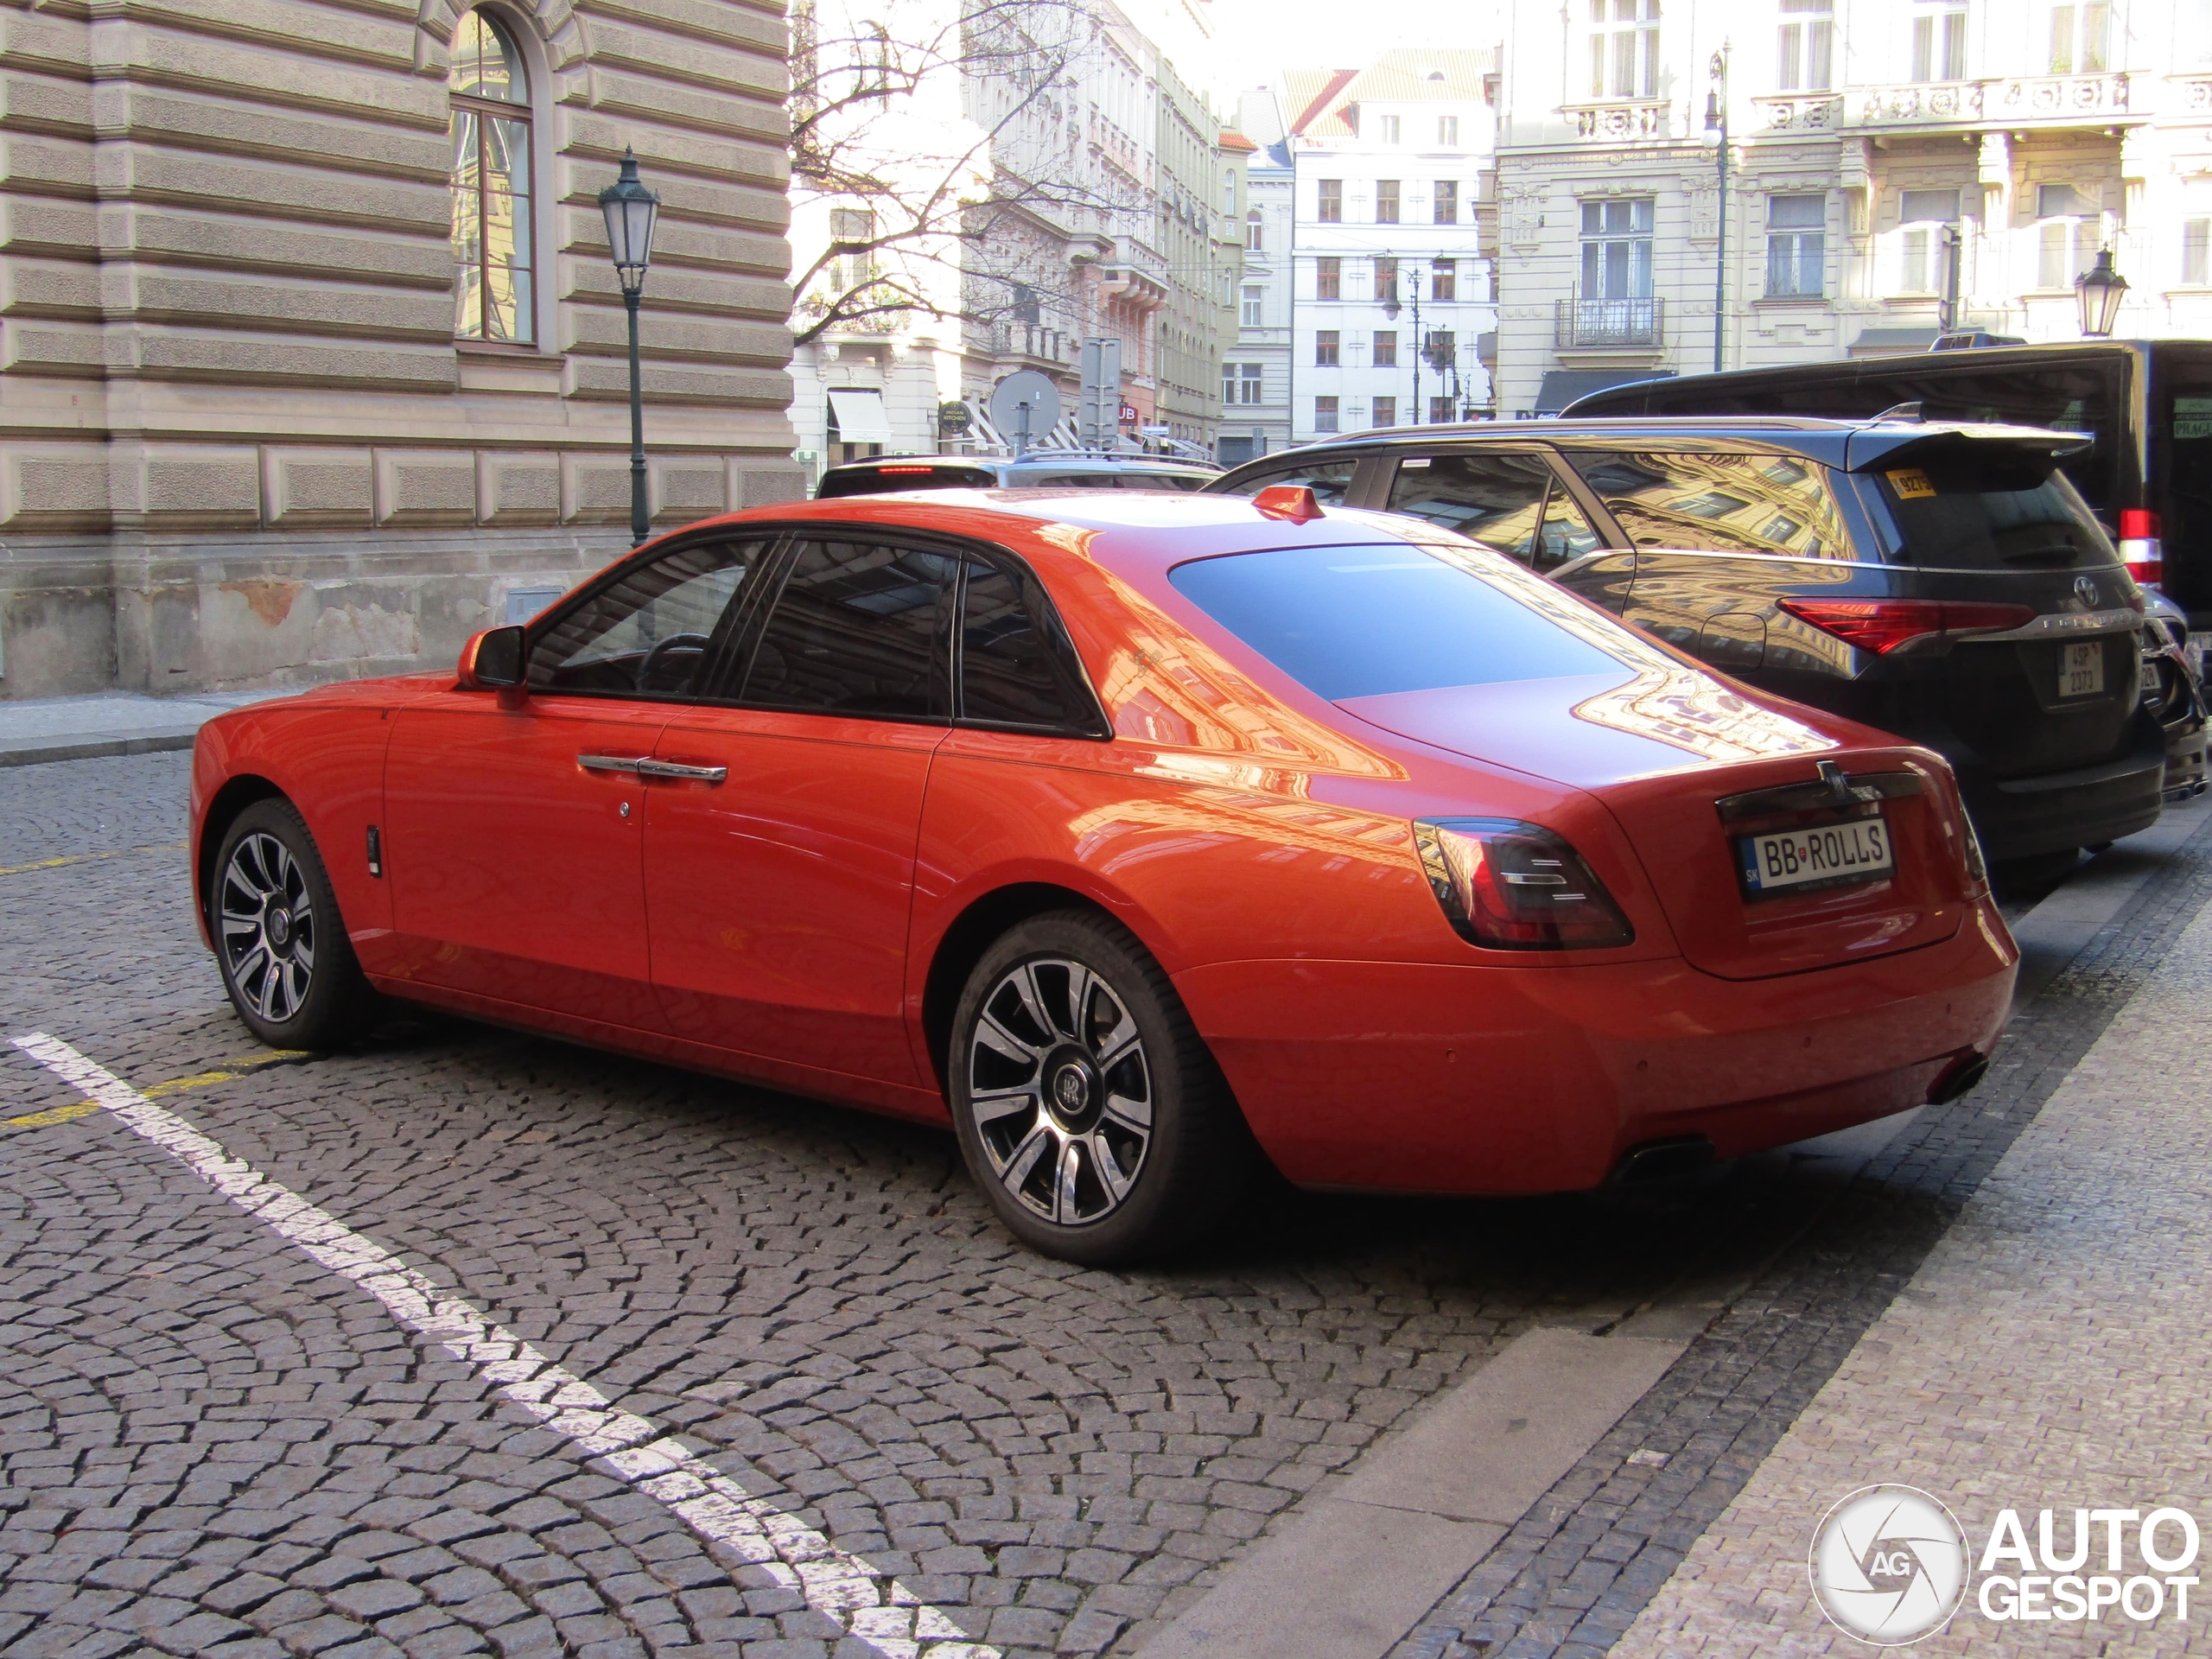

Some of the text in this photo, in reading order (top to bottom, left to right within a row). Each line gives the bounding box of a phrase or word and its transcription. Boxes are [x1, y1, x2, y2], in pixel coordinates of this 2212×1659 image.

[1119, 407, 1135, 420] UB
[1764, 824, 1884, 878] BB ROLLS
[1745, 868, 1759, 882] SK
